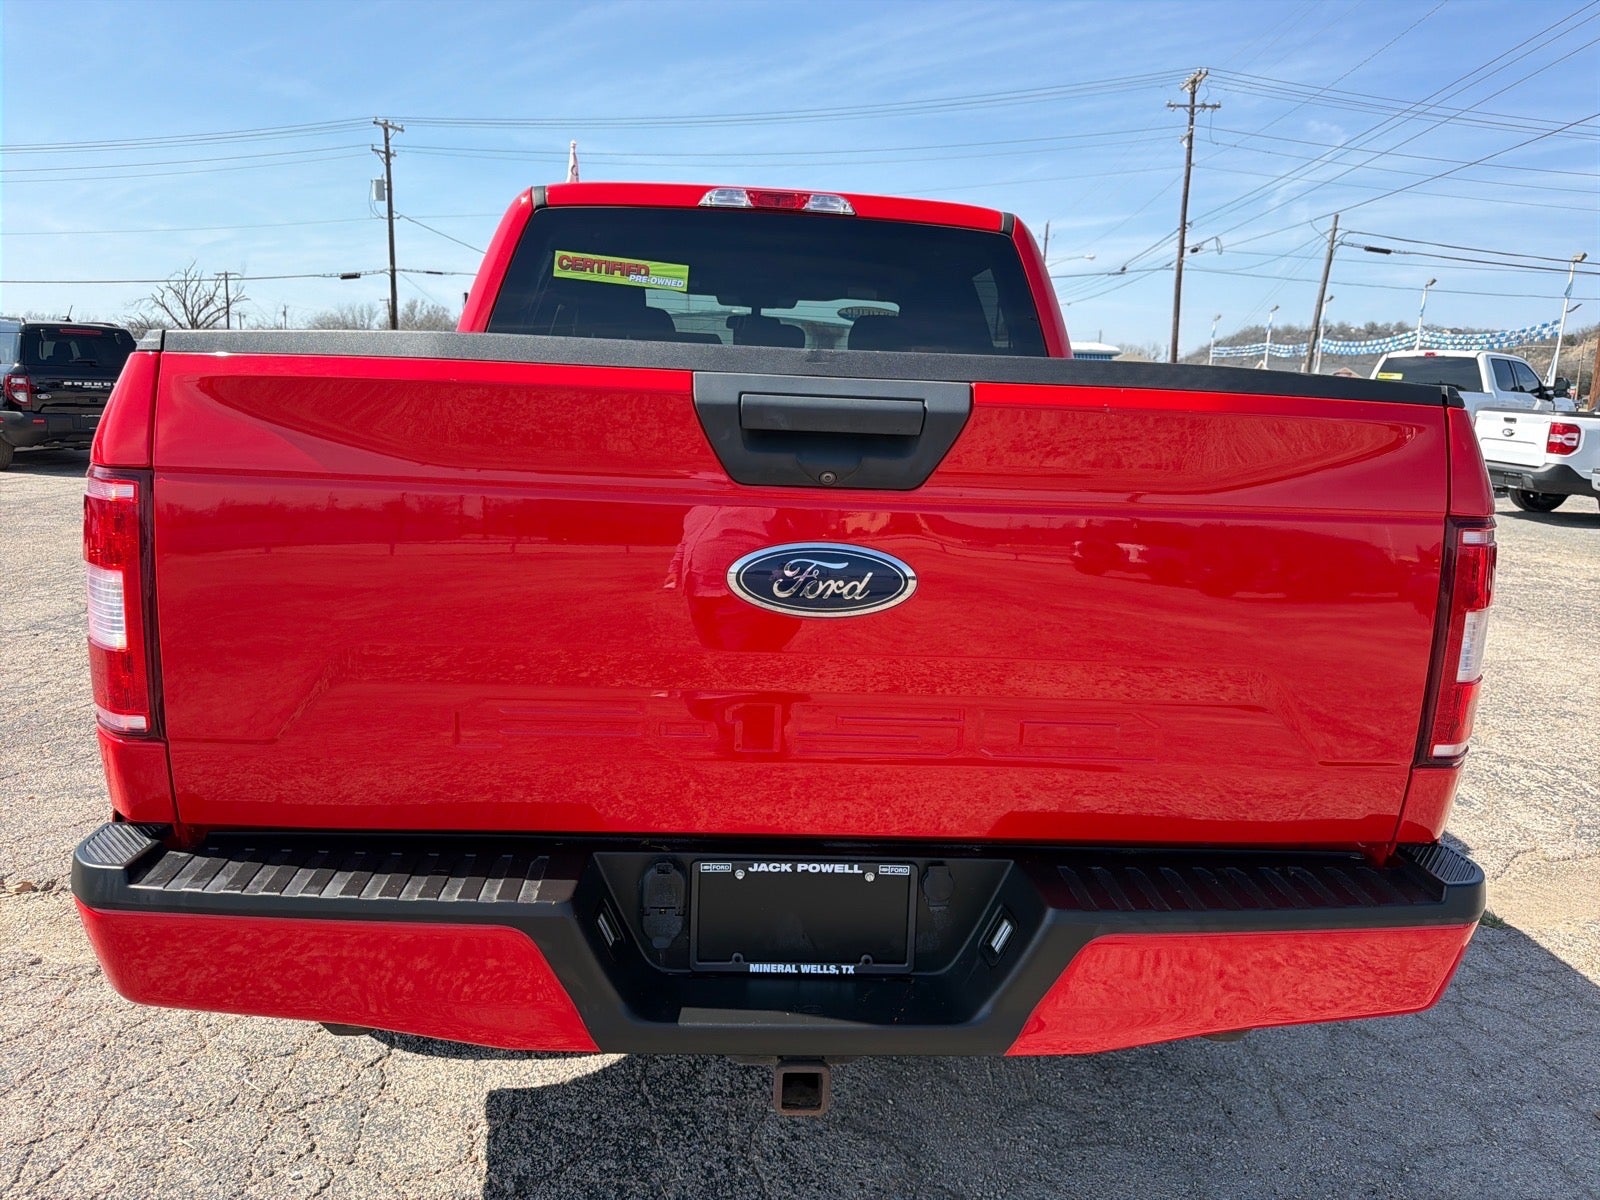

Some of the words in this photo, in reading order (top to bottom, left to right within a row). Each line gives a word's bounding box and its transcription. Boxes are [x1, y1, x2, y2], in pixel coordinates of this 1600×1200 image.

[558, 255, 650, 277] CERTIFIED
[629, 274, 684, 288] PRE-OWNED
[772, 558, 873, 600] Ford
[748, 862, 793, 873] JACK
[796, 863, 864, 874] POWELL
[749, 963, 799, 974] MINERAL
[800, 964, 840, 975] WELLS,
[841, 965, 855, 975] TX
